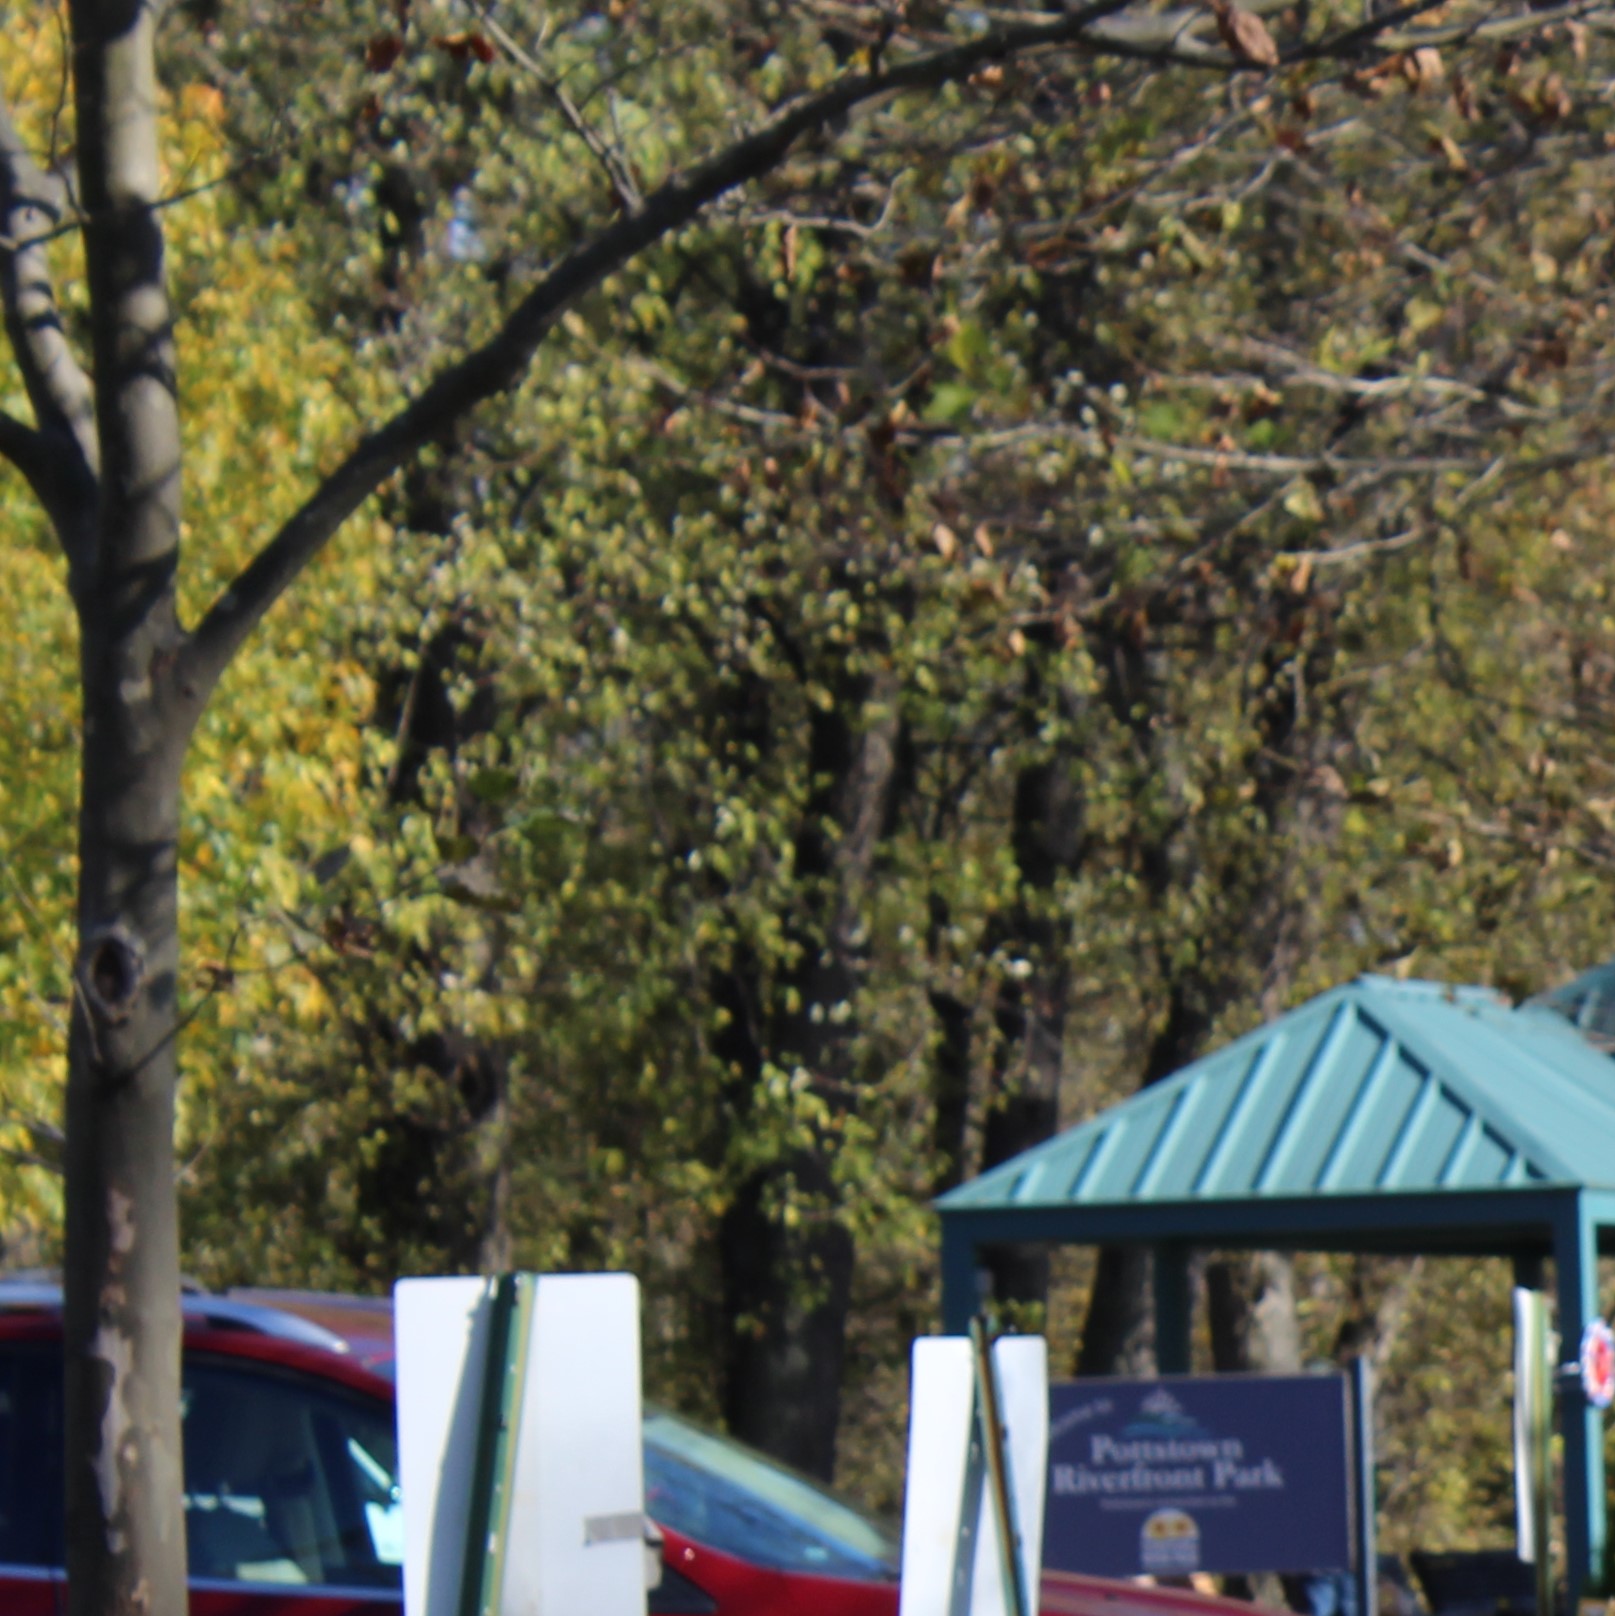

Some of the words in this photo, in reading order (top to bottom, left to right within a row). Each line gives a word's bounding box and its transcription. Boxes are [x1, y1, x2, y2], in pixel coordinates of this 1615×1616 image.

[1090, 1435, 1244, 1464] Pottstown
[1053, 1462, 1205, 1494] Riverfront
[1213, 1457, 1284, 1490] Park
